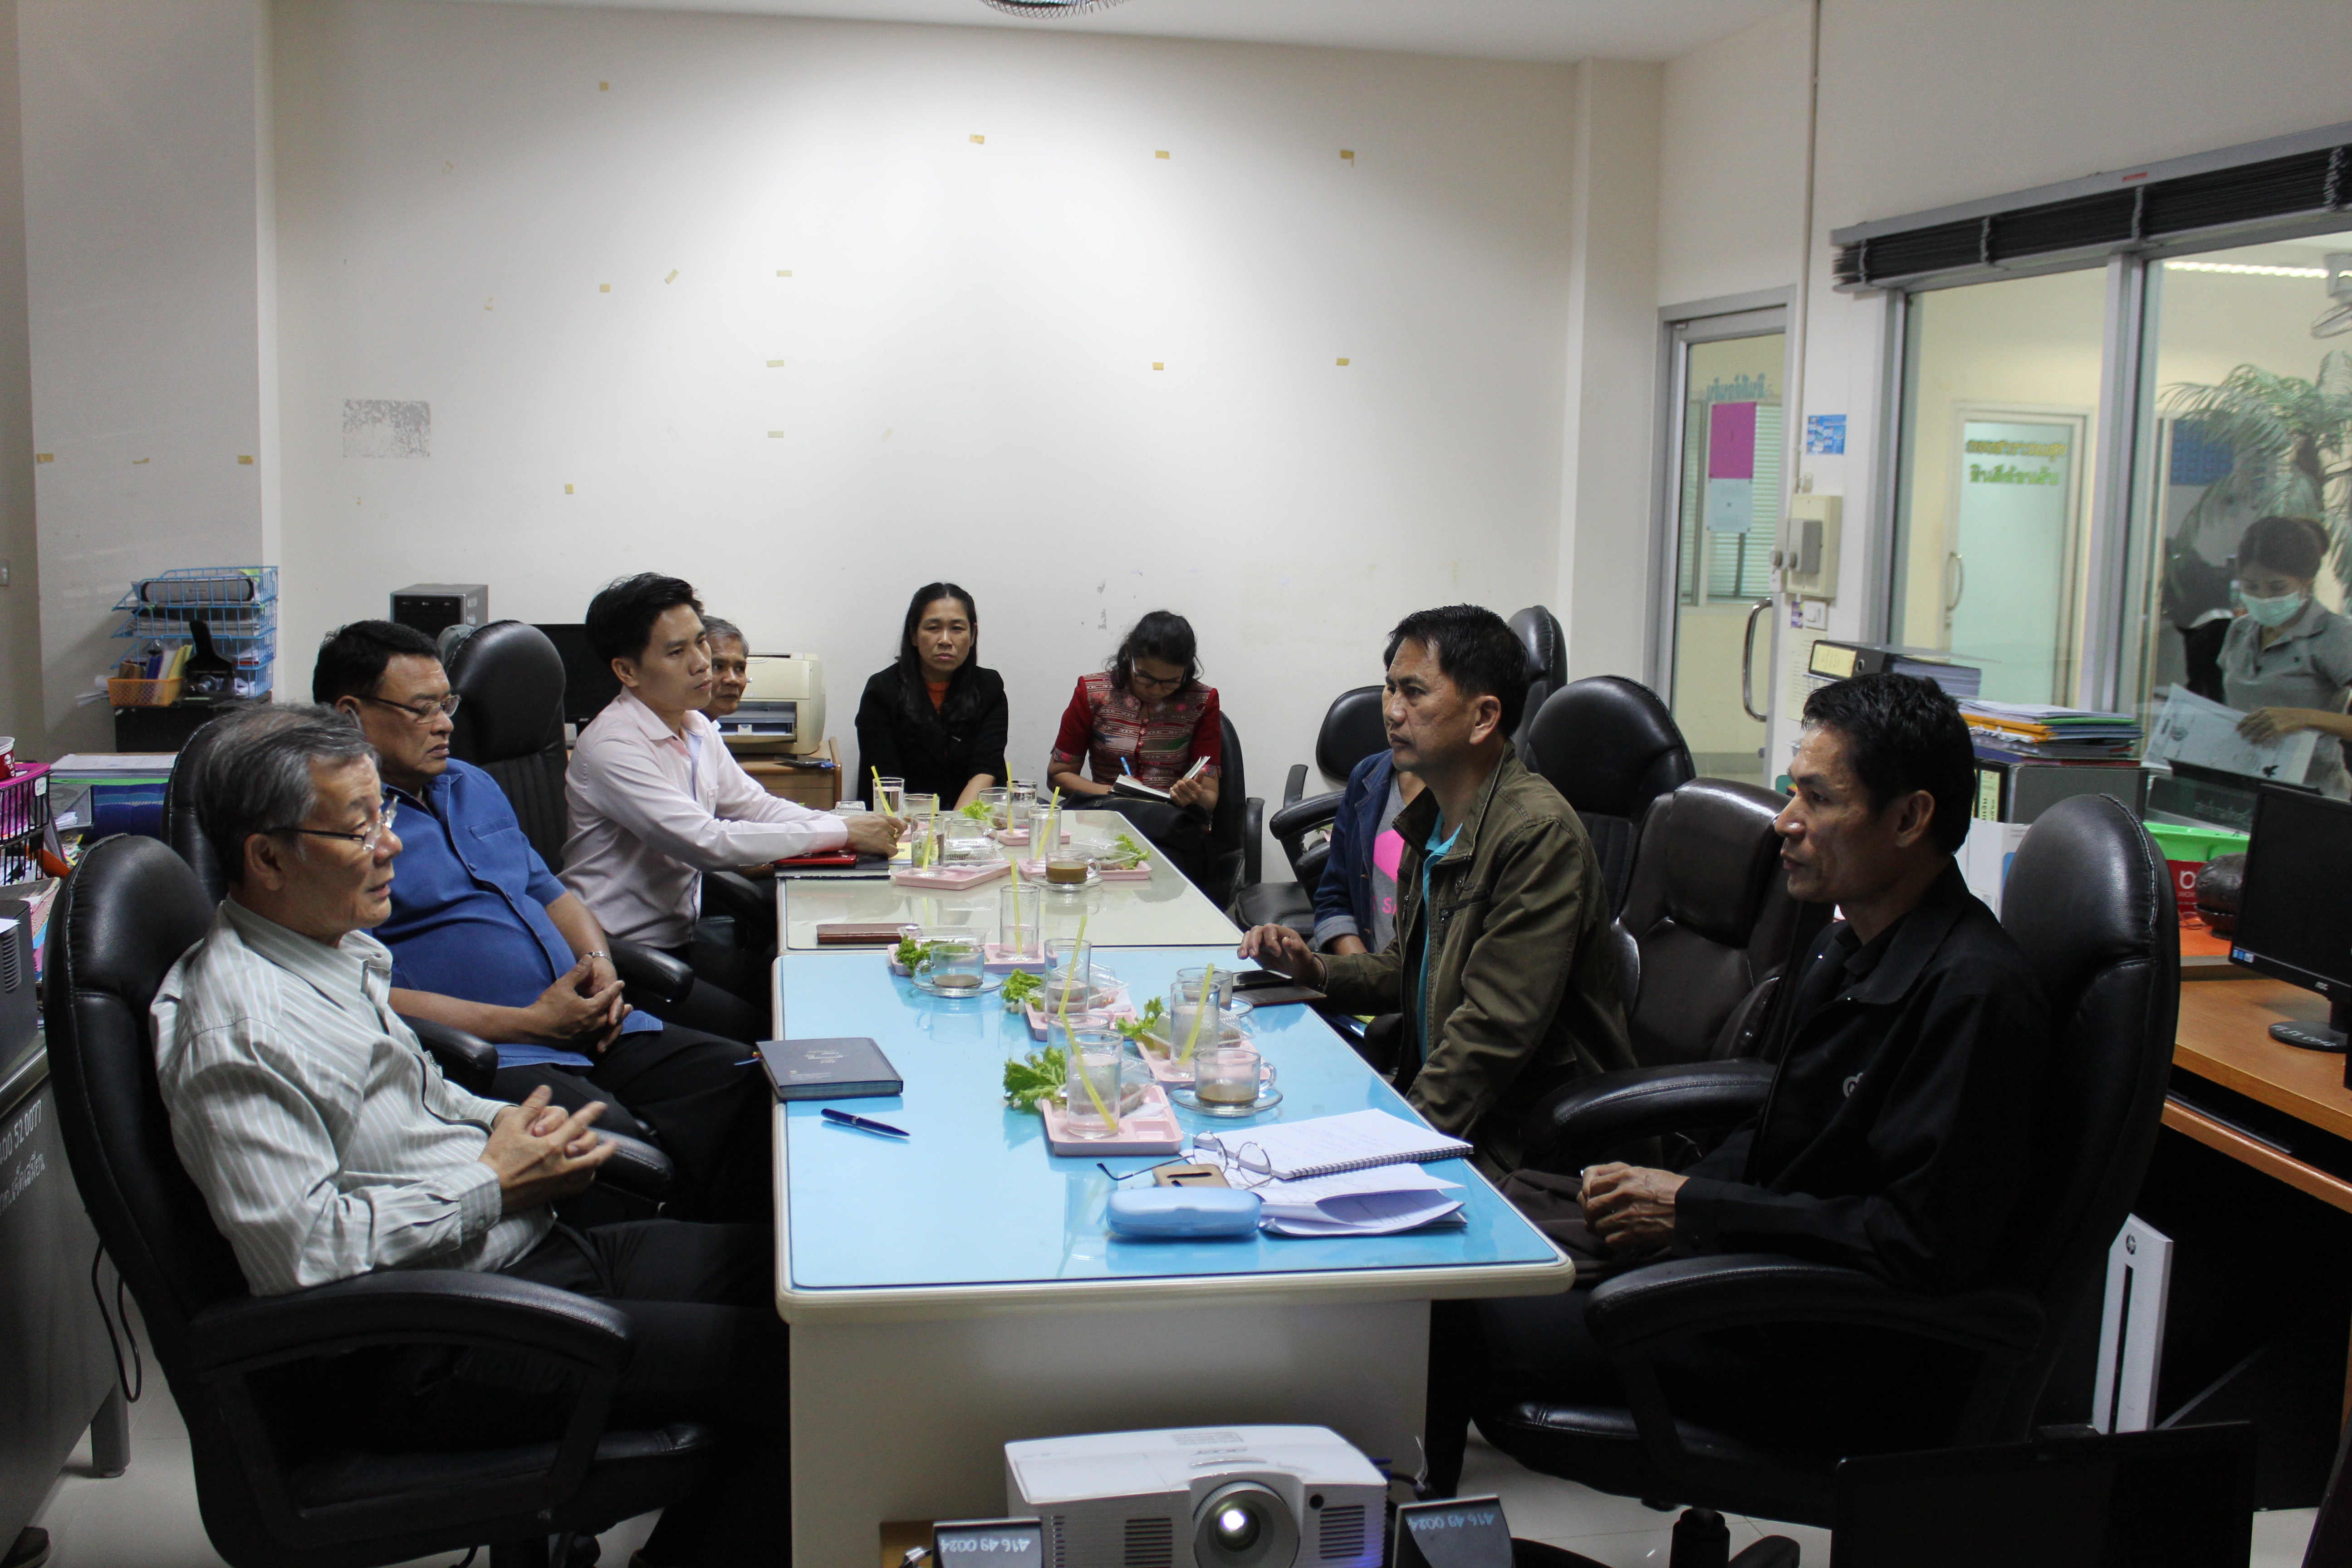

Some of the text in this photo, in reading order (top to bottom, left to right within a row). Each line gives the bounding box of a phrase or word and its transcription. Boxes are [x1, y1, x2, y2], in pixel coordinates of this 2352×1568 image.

[15, 1119, 24, 1149] 52
[24, 1099, 41, 1136] 0077
[1408, 1515, 1445, 1531] 0024
[941, 1538, 1030, 1553] 416 49 0024
